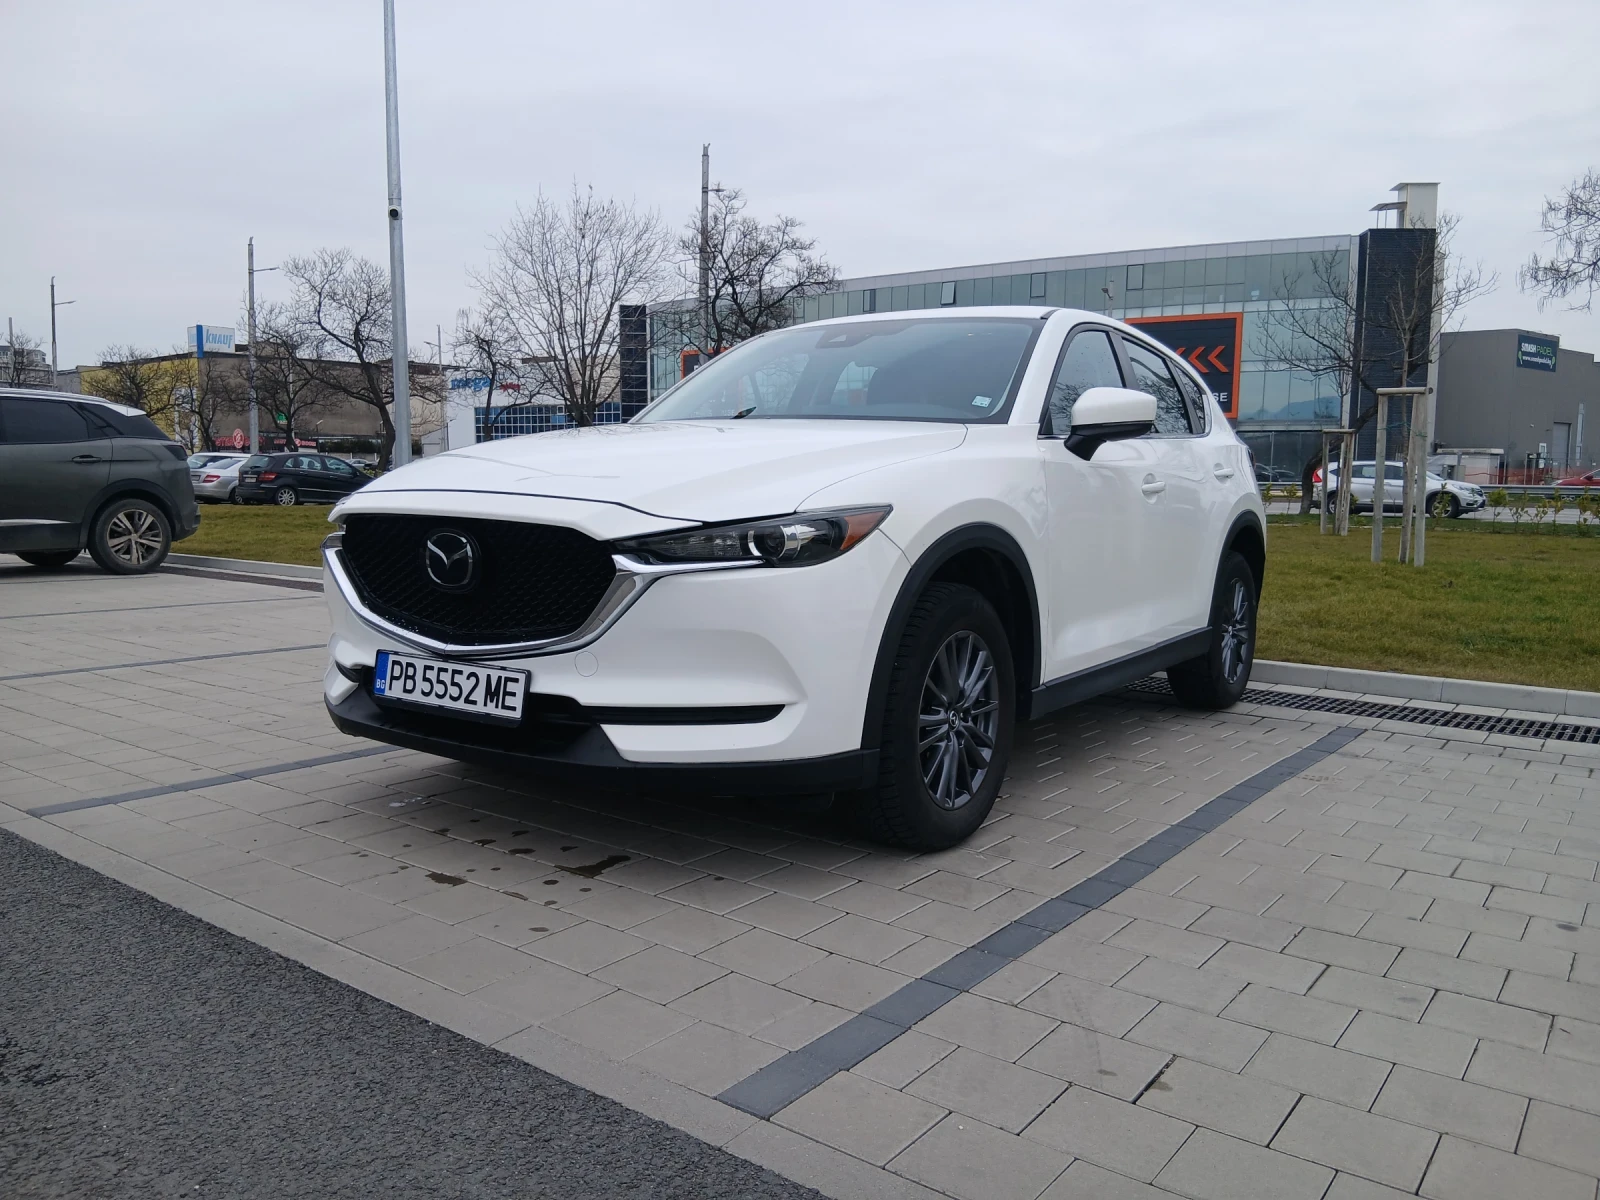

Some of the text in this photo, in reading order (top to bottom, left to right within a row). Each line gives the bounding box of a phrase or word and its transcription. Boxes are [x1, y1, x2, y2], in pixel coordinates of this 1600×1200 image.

[205, 328, 233, 349] KNAUF
[1521, 342, 1553, 357] SMASH PADEL
[376, 678, 386, 690] BG
